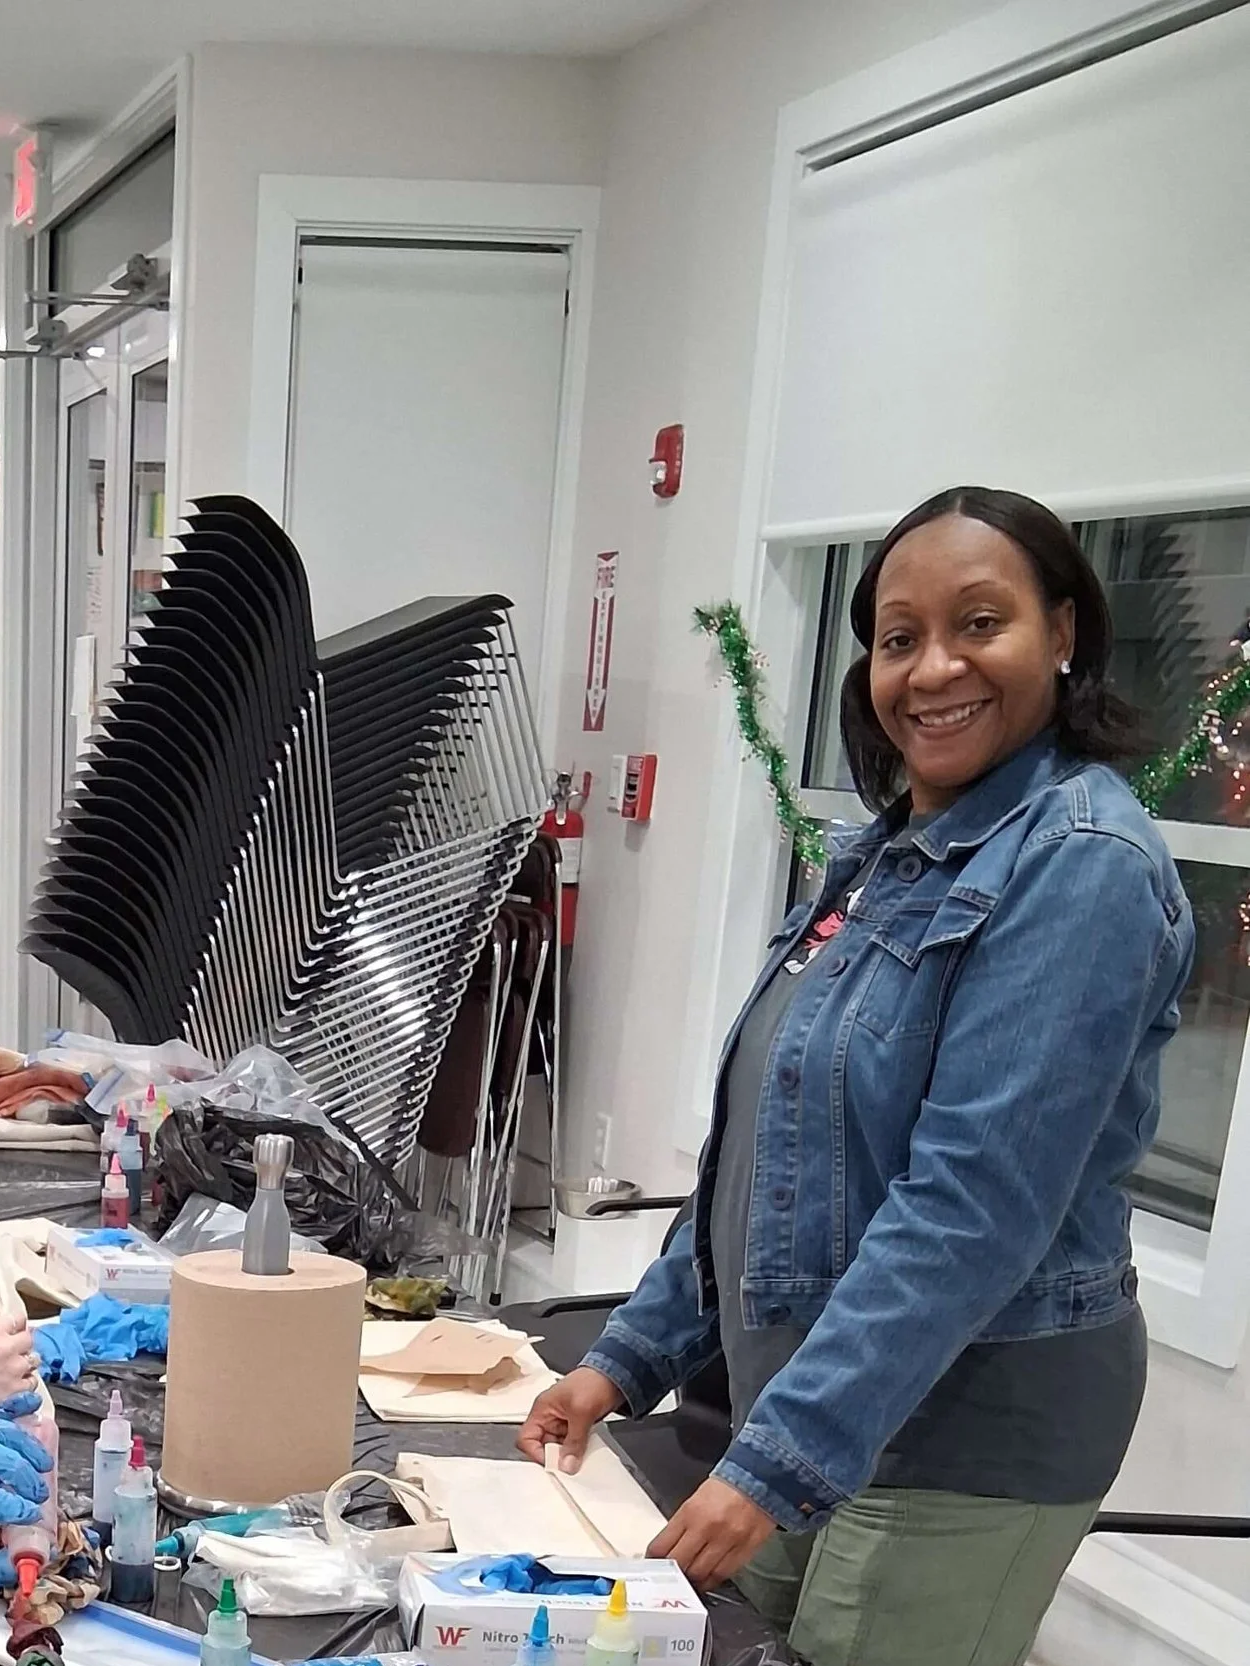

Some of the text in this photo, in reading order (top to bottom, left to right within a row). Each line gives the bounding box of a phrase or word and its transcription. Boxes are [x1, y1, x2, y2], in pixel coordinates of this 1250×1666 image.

[435, 1626, 472, 1646] WF
[482, 1631, 518, 1644] Nitro
[523, 1633, 564, 1645] Tch
[671, 1640, 694, 1651] 100
